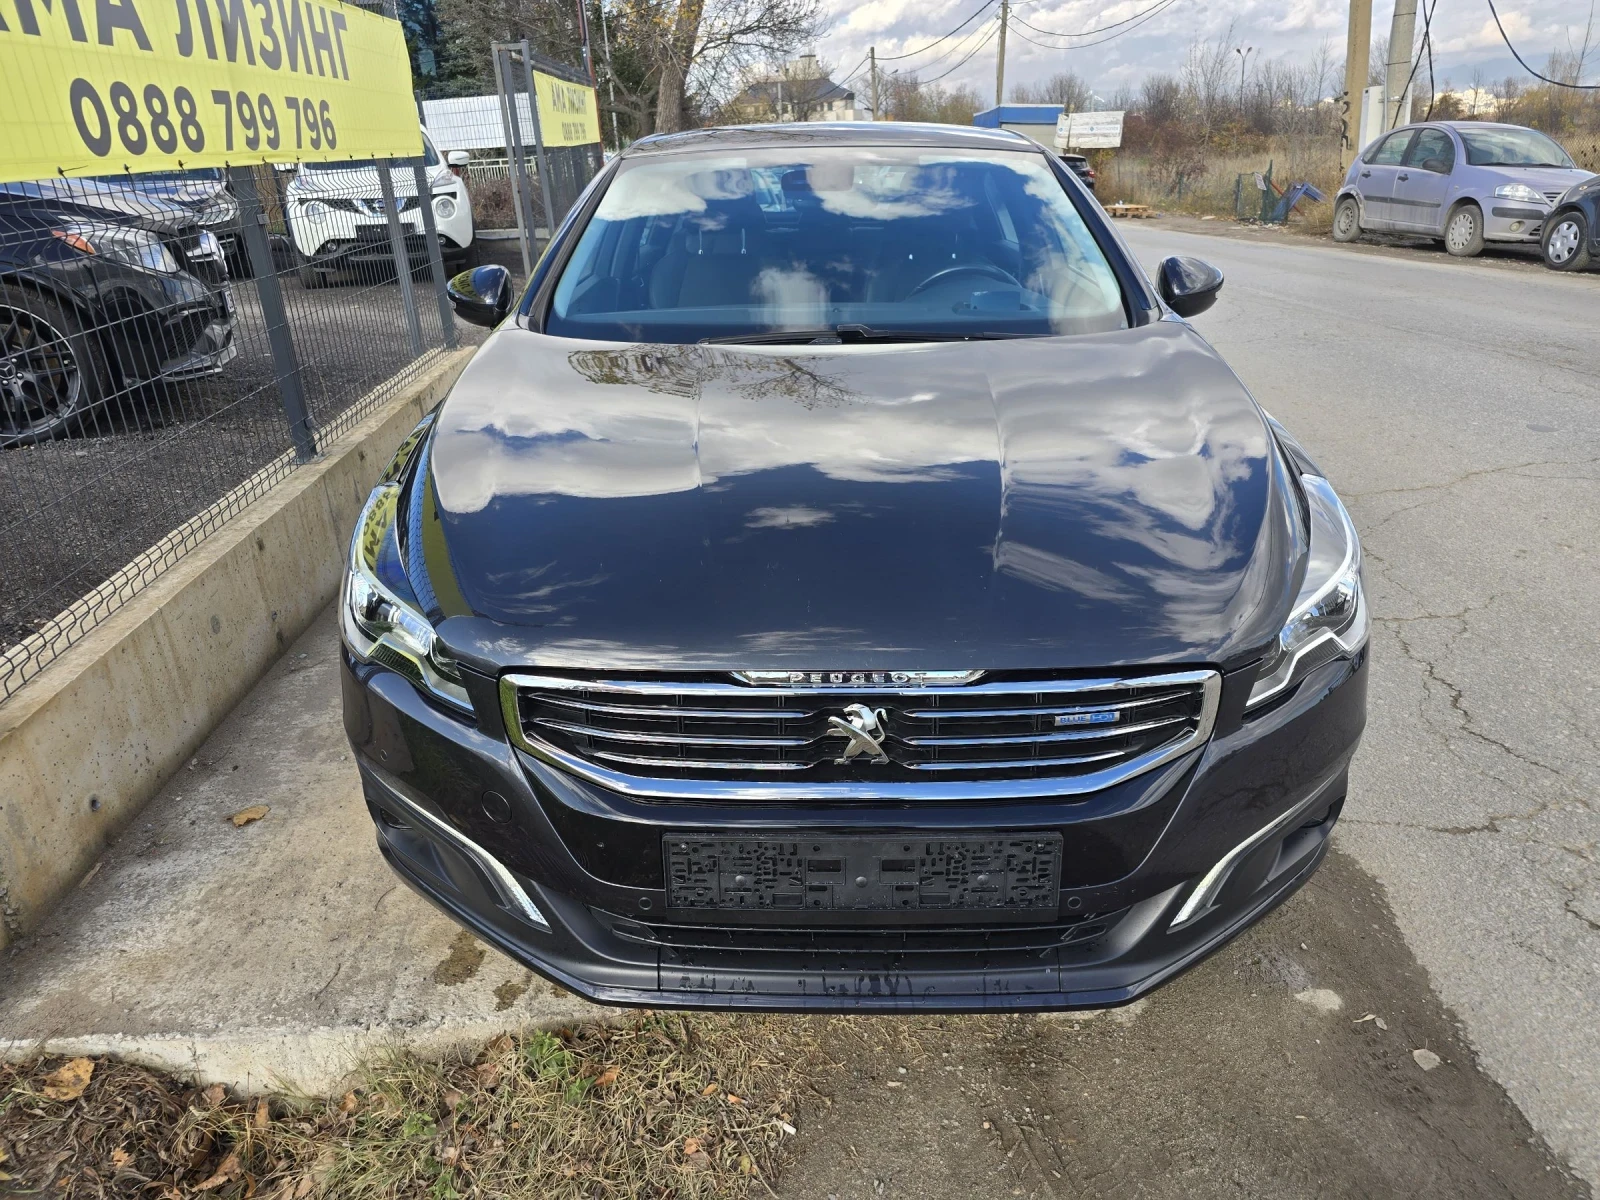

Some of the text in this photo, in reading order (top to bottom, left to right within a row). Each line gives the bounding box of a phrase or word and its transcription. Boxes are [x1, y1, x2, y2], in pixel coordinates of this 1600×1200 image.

[175, 0, 350, 81] ЛИЗИНГ
[70, 77, 337, 157] 0888 799 796
[789, 672, 927, 684] PEUGEOT
[1060, 716, 1087, 724] BLUE
